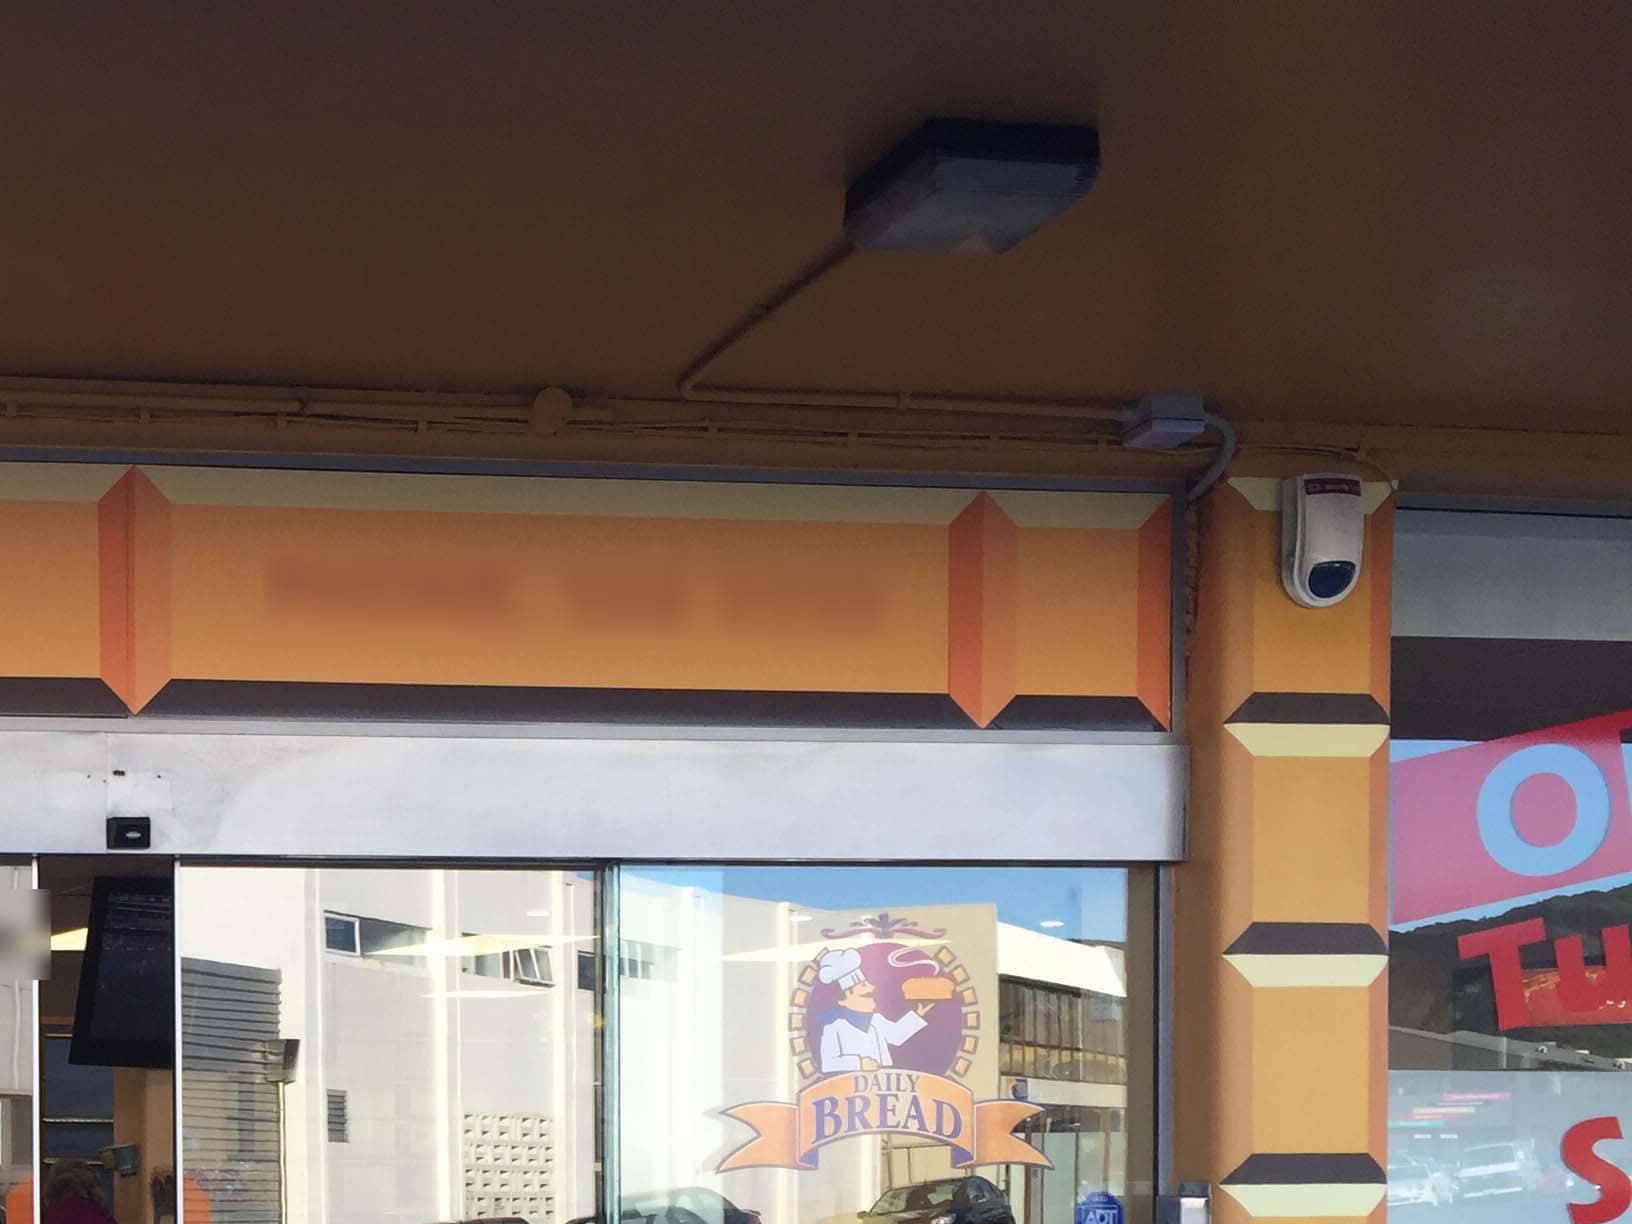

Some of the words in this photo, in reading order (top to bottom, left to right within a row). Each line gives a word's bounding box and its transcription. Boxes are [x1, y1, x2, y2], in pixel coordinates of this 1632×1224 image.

[1475, 742, 1632, 878] O
[853, 1073, 921, 1093] DAILY
[811, 1093, 963, 1145] BREAD
